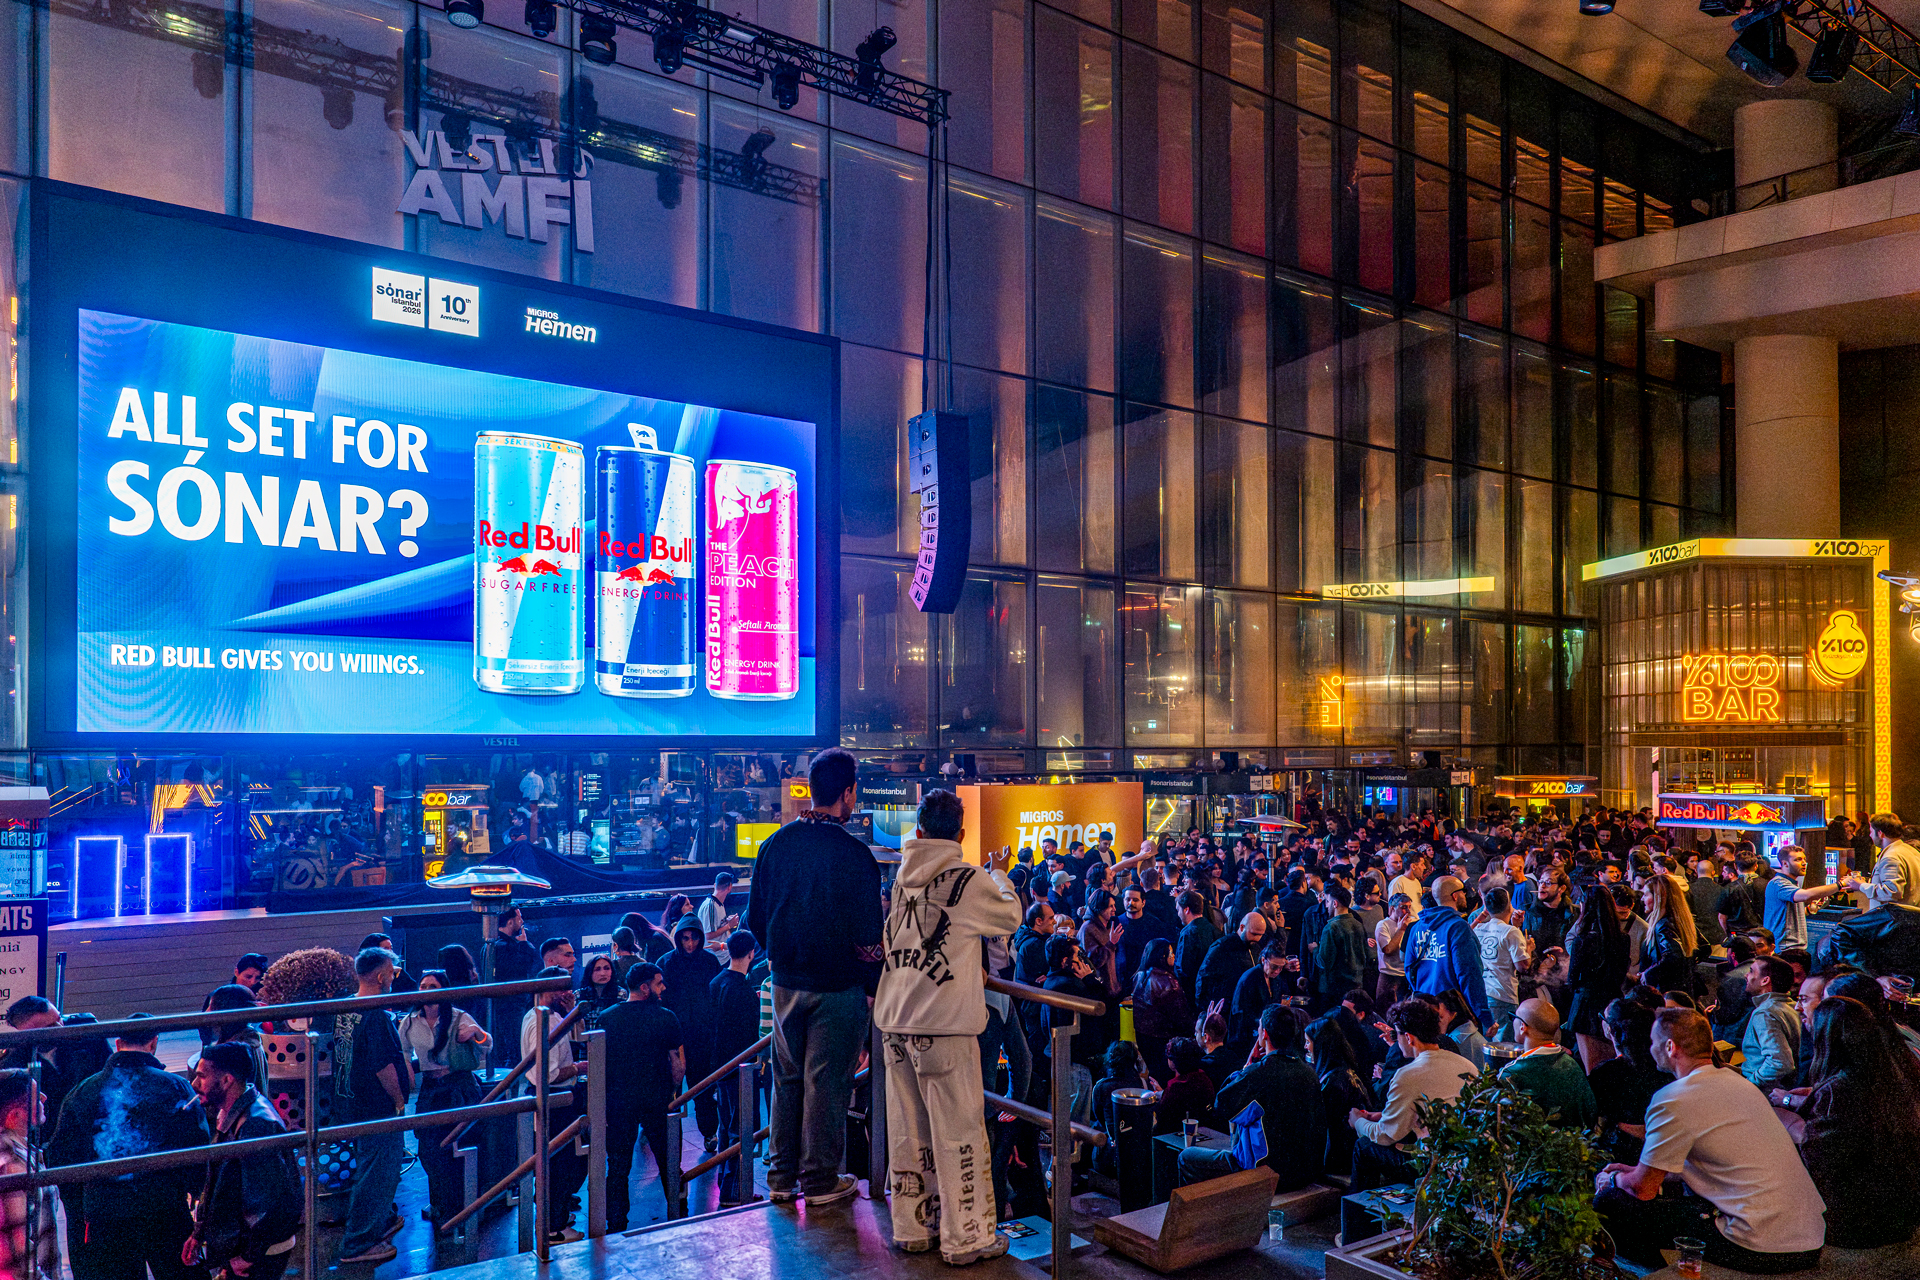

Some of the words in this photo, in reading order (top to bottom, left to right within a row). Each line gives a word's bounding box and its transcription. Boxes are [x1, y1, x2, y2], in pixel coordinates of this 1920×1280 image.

[396, 169, 594, 253] AMFI
[402, 306, 421, 315] 2026
[440, 314, 470, 324] Anniversary
[524, 314, 596, 343] Hemen
[107, 387, 208, 448] ALL
[226, 402, 315, 459] SET
[332, 415, 429, 473] FOR
[106, 449, 429, 558] SÓNAR?
[480, 520, 528, 549] Red
[535, 524, 580, 553] Bull
[600, 531, 645, 559] Red
[650, 535, 692, 563] Bull
[710, 542, 727, 551] THE
[710, 552, 794, 579] PEACH
[601, 586, 649, 599] ENERGY
[654, 590, 689, 601] DRINK
[710, 575, 756, 588] EDITION
[708, 594, 721, 638] Bull
[111, 644, 155, 667] RED
[162, 645, 215, 669] BULL
[221, 648, 283, 671] GIVES
[289, 651, 333, 673] YOU
[340, 653, 425, 675] WIIINGS.
[626, 665, 645, 675] Enerji
[708, 641, 721, 686] Red
[724, 659, 755, 668] ENERGY
[758, 660, 781, 669] DRINK
[1682, 654, 1780, 688] %100
[1683, 686, 1780, 720] BAR
[483, 737, 520, 747] VESTEL
[1530, 781, 1585, 794] %100bar
[1662, 802, 1693, 819] Red
[1694, 804, 1726, 821] Bull
[1015, 822, 1116, 851] Hemen
